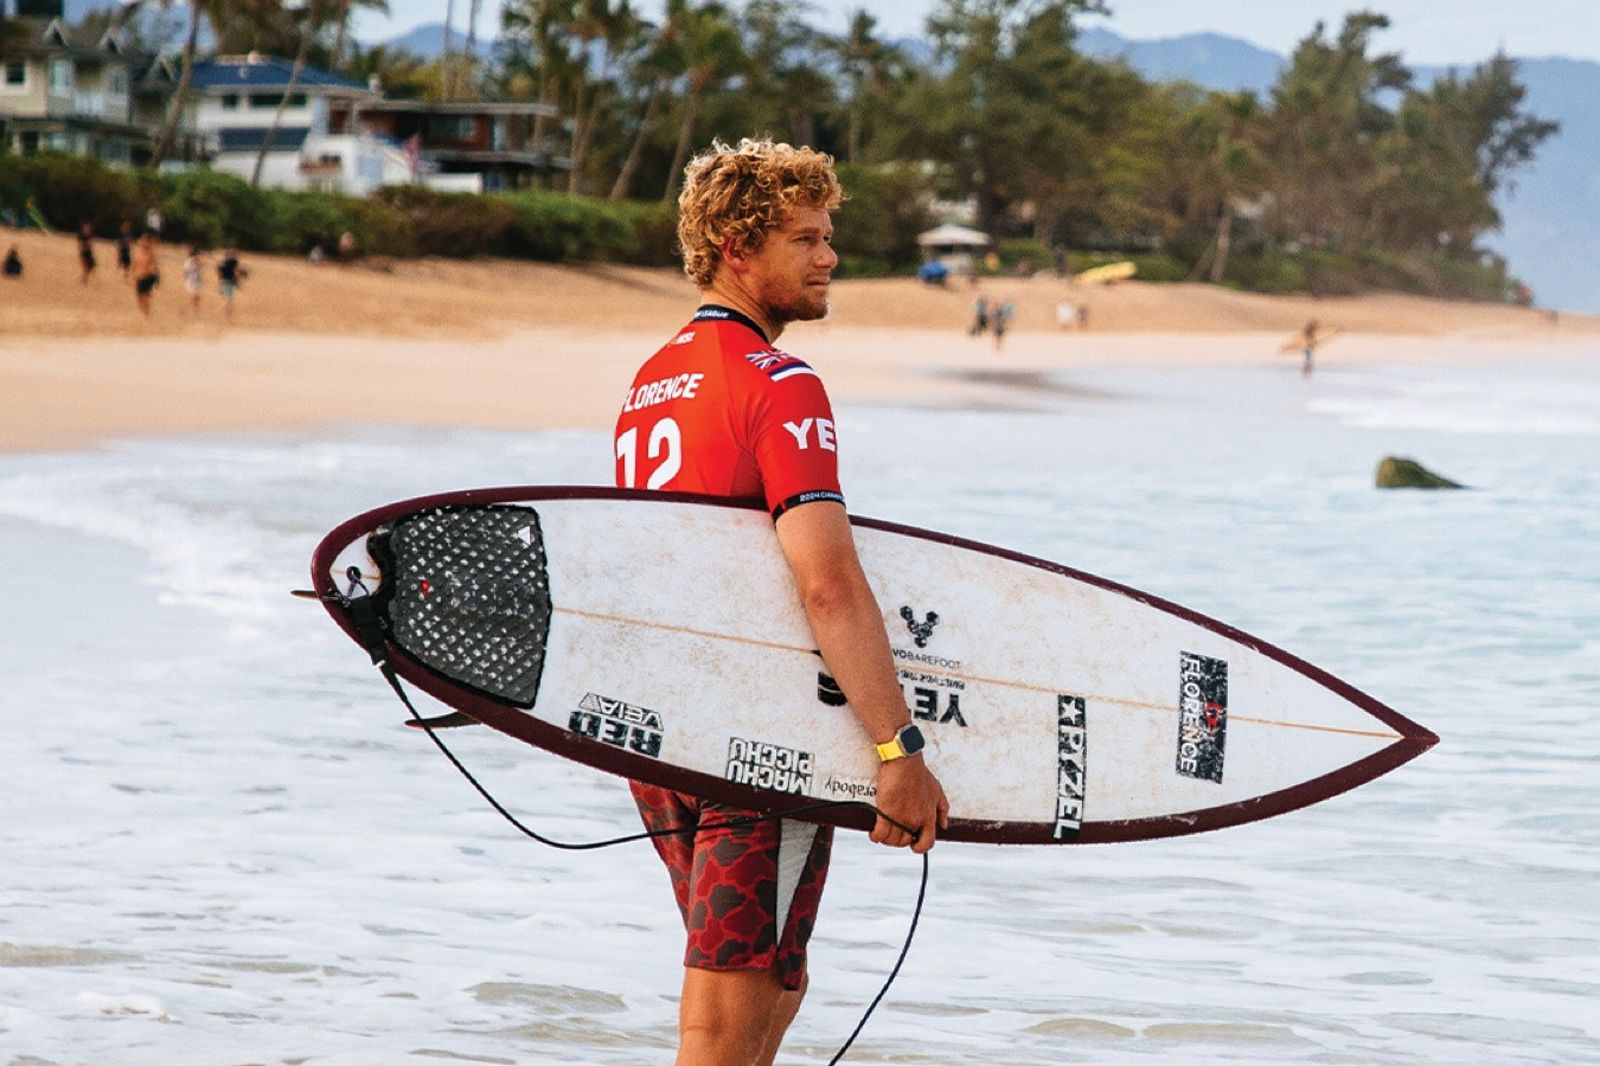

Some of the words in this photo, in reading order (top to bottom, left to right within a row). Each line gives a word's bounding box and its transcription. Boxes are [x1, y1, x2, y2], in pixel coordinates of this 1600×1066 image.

[622, 373, 704, 412] LORENCE
[616, 417, 682, 490] 12
[900, 684, 967, 727] YE
[1180, 656, 1201, 774] FLORENCE
[568, 711, 662, 758] RED
[727, 760, 812, 796] MACHU
[729, 738, 815, 775] PICCHU
